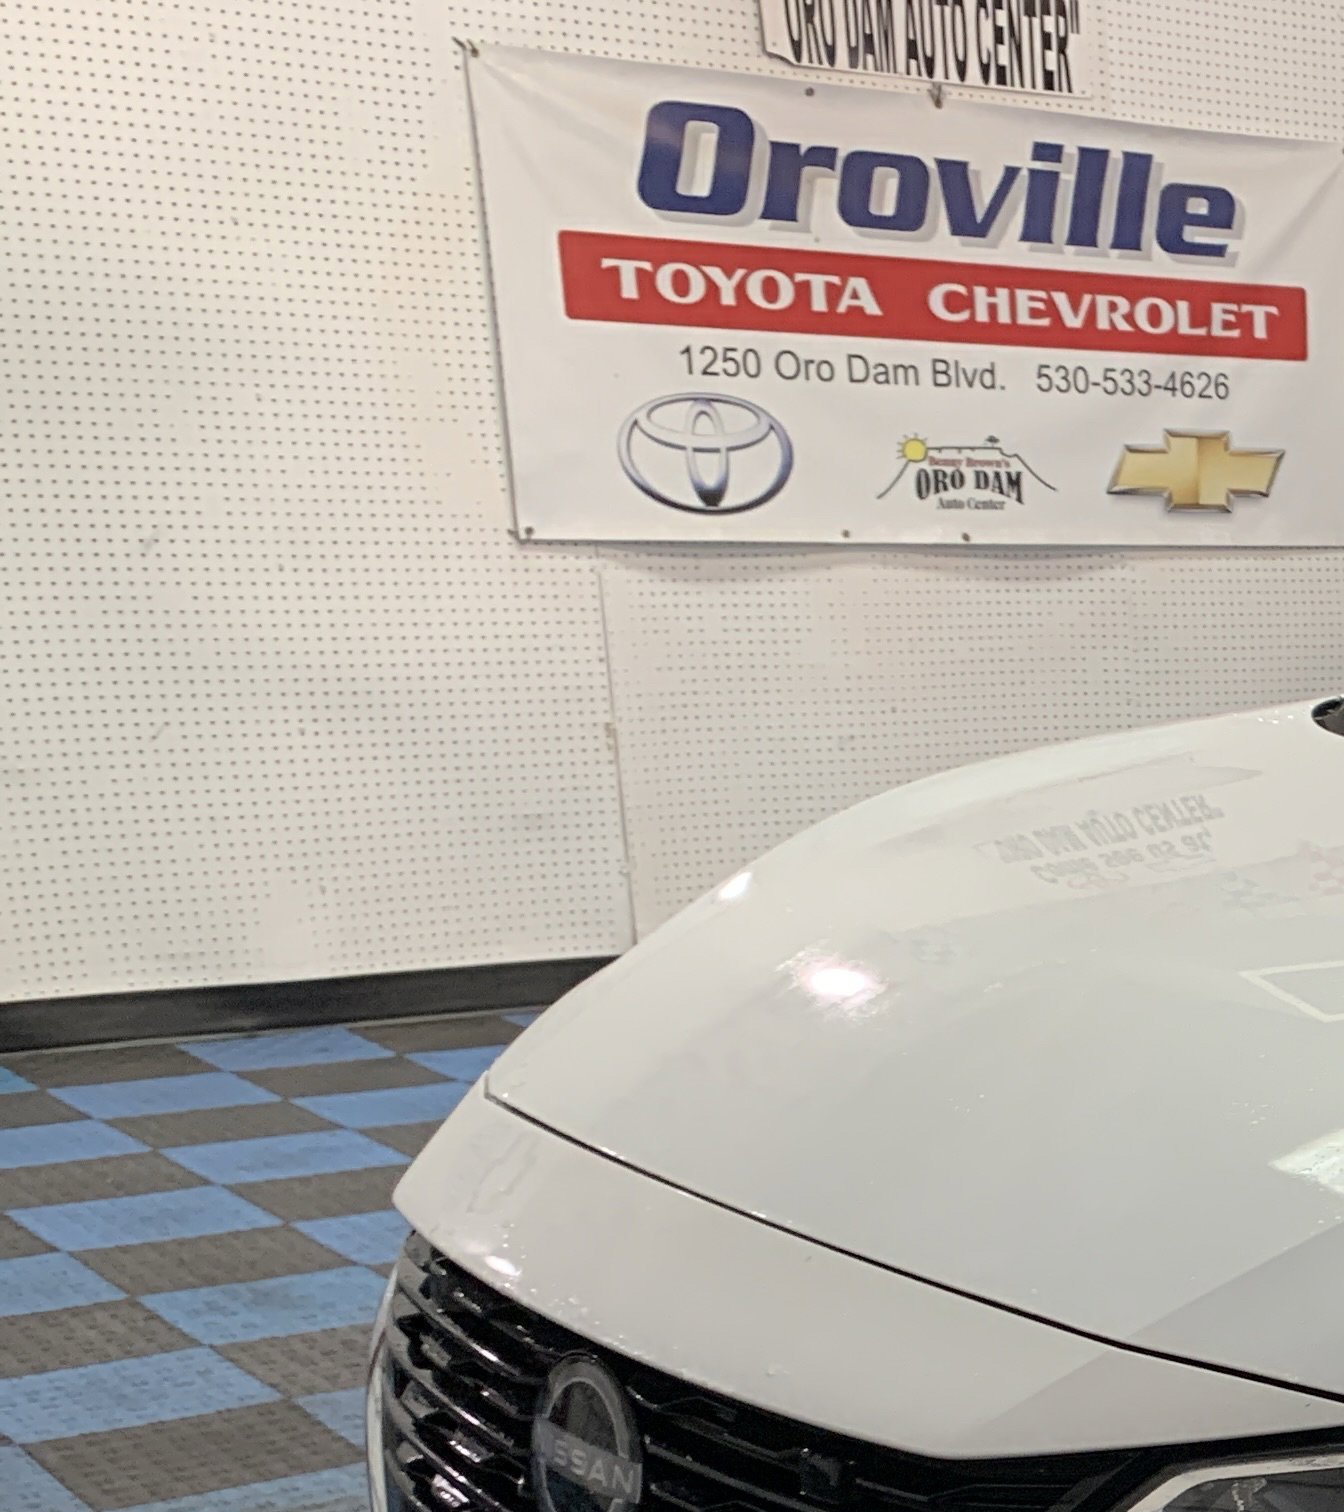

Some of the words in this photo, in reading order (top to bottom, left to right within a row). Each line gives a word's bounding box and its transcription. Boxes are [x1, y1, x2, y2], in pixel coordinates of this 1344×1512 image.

[843, 0, 897, 74] DAM
[902, 0, 967, 83] AUTO
[637, 101, 1240, 261] Oroville
[601, 258, 883, 316] TOYOTA
[927, 283, 1279, 340] CHEVROLET
[680, 345, 762, 379] 1250
[774, 349, 835, 382] Oro
[847, 354, 920, 387] Dam
[932, 359, 1007, 392] Blvd.
[1036, 364, 1231, 401] 530-533-4626
[916, 468, 966, 500] ORO
[974, 469, 1024, 505] DAM
